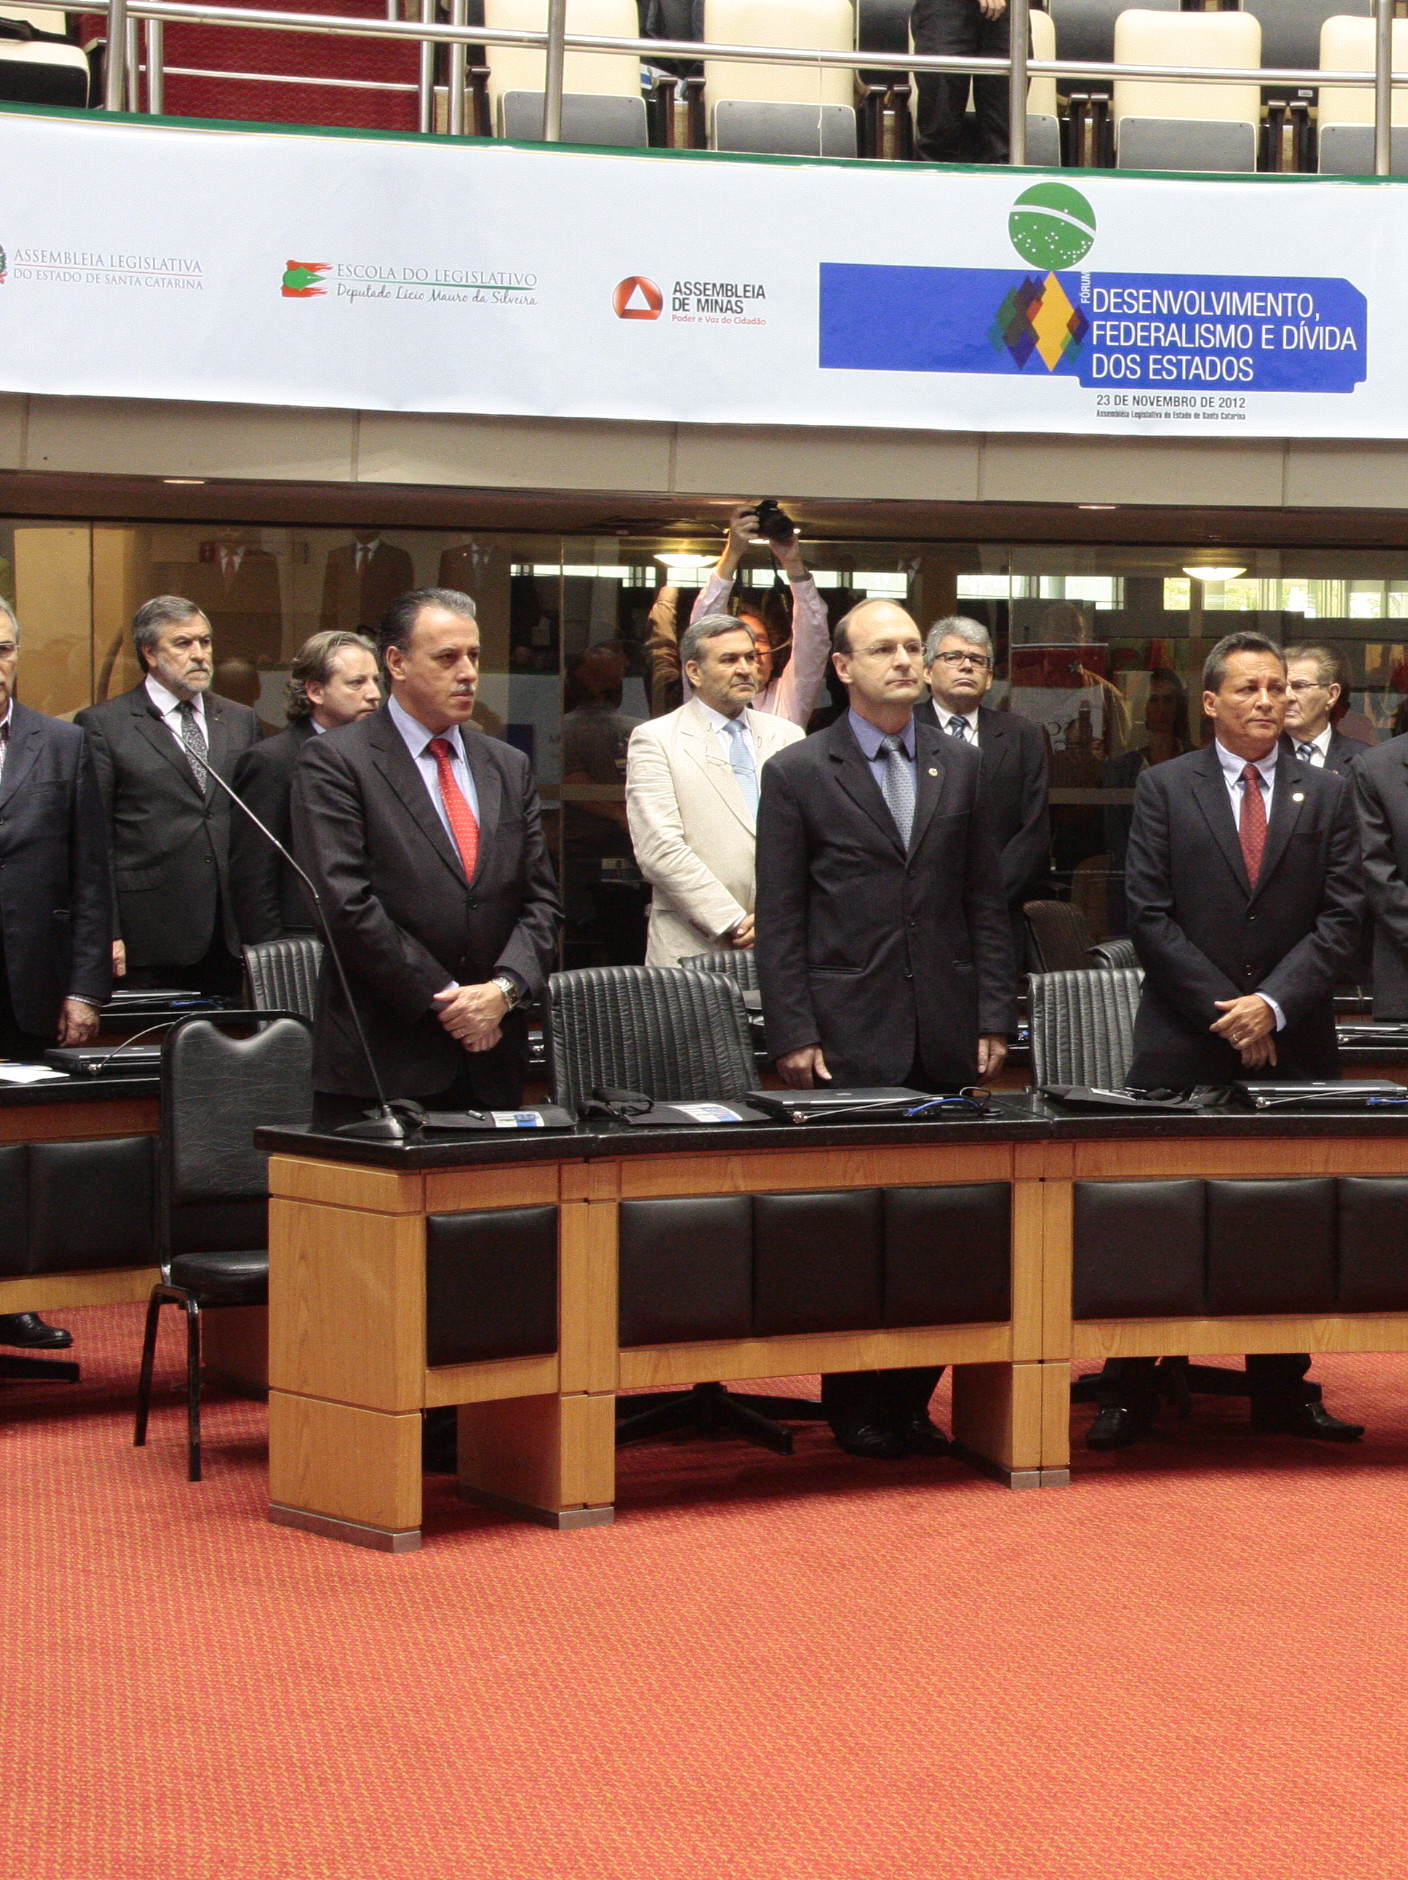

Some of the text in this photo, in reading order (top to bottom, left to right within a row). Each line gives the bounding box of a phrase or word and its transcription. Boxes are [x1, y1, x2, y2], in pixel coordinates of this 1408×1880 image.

[14, 249, 202, 273] ASSEMBLEIA LEGISLATIVA
[13, 269, 203, 290] DO ESTADO DE SANTA CATARINA
[337, 264, 537, 286] ESCOLA DO LEGISLATIVO
[337, 283, 537, 305] Deputado Lício Mauro da Silveira
[673, 281, 766, 299] ASSEMBLEIA
[1080, 272, 1091, 304] FÓRUM
[672, 297, 743, 314] DE MINAS
[1092, 288, 1320, 321] DESENVOLVIMENTO,
[672, 314, 696, 322] Poder
[721, 316, 732, 324] do
[734, 317, 766, 325] Cidadão
[1092, 321, 1357, 351] FEDERALISMO E DÍVIDA
[1092, 354, 1254, 381] DOS ESTADOS
[1097, 395, 1246, 408] 23 DE NOVEMBRO DE 2012
